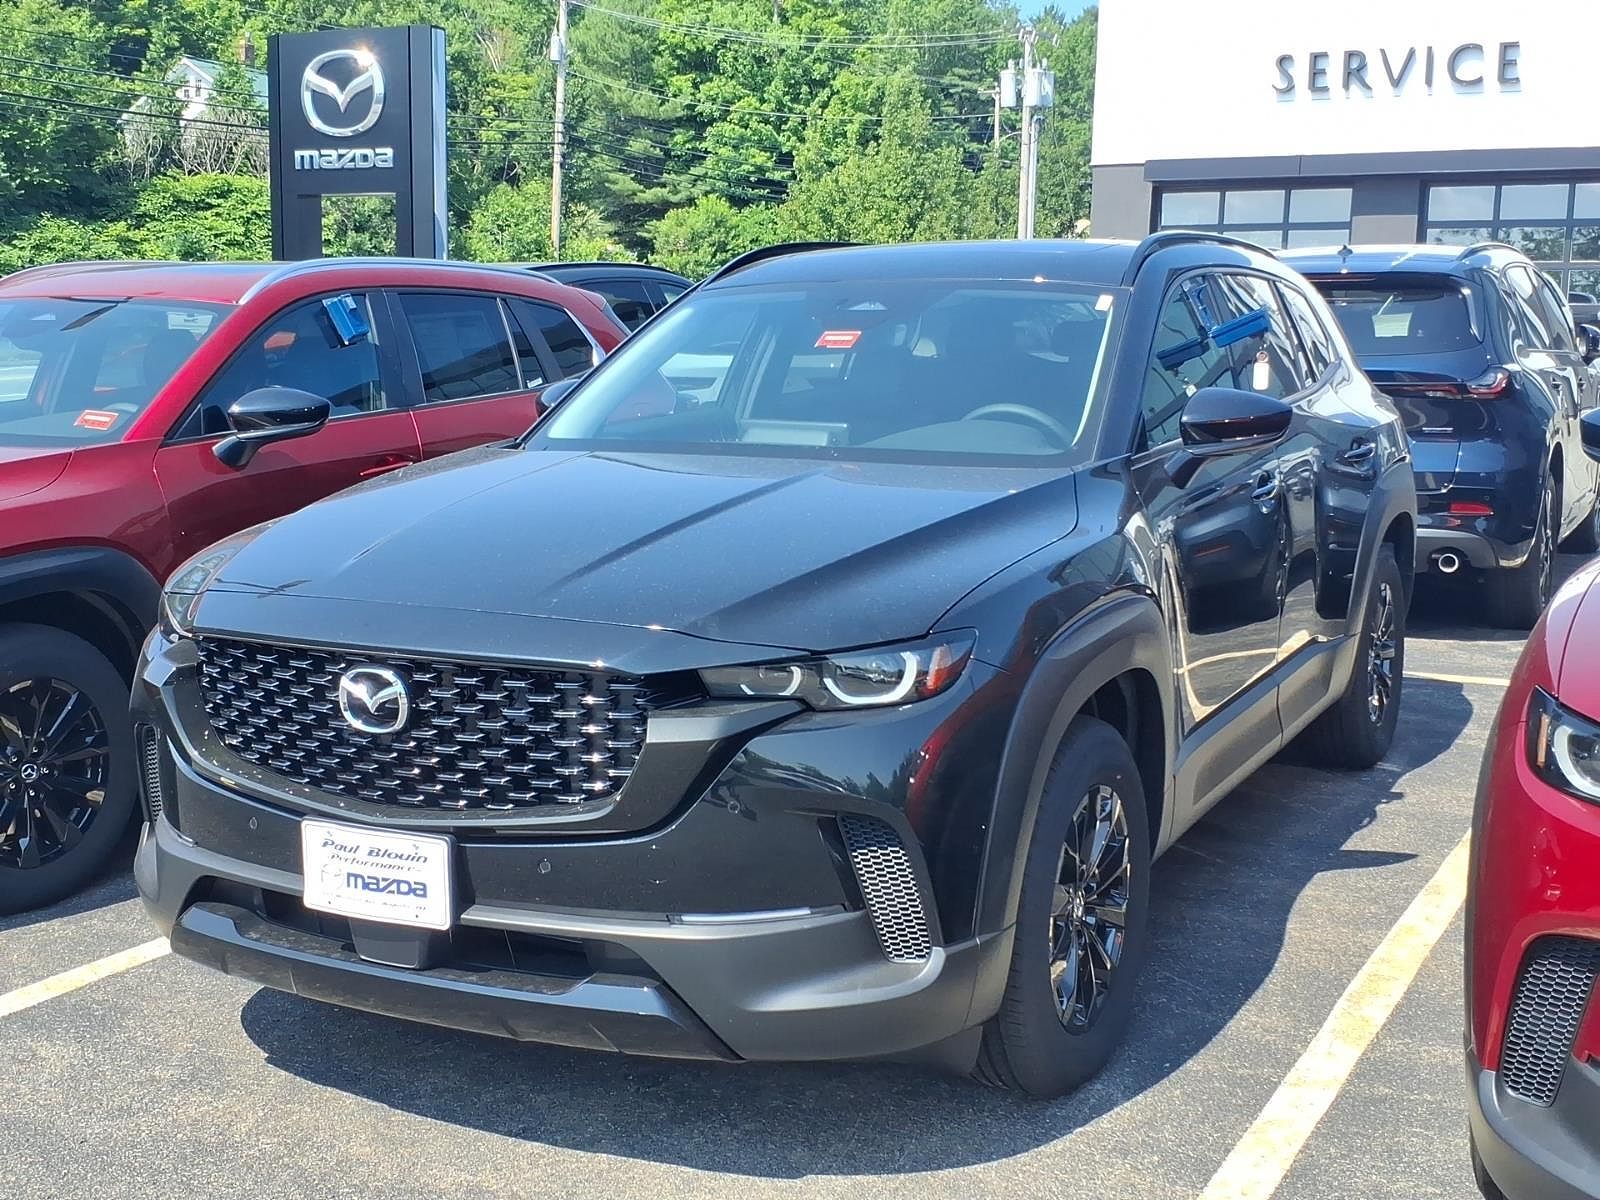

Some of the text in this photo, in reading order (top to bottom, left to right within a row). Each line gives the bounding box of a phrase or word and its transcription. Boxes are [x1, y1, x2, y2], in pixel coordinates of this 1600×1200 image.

[1272, 41, 1521, 93] SERVICE
[320, 838, 428, 864] Paul Blouin
